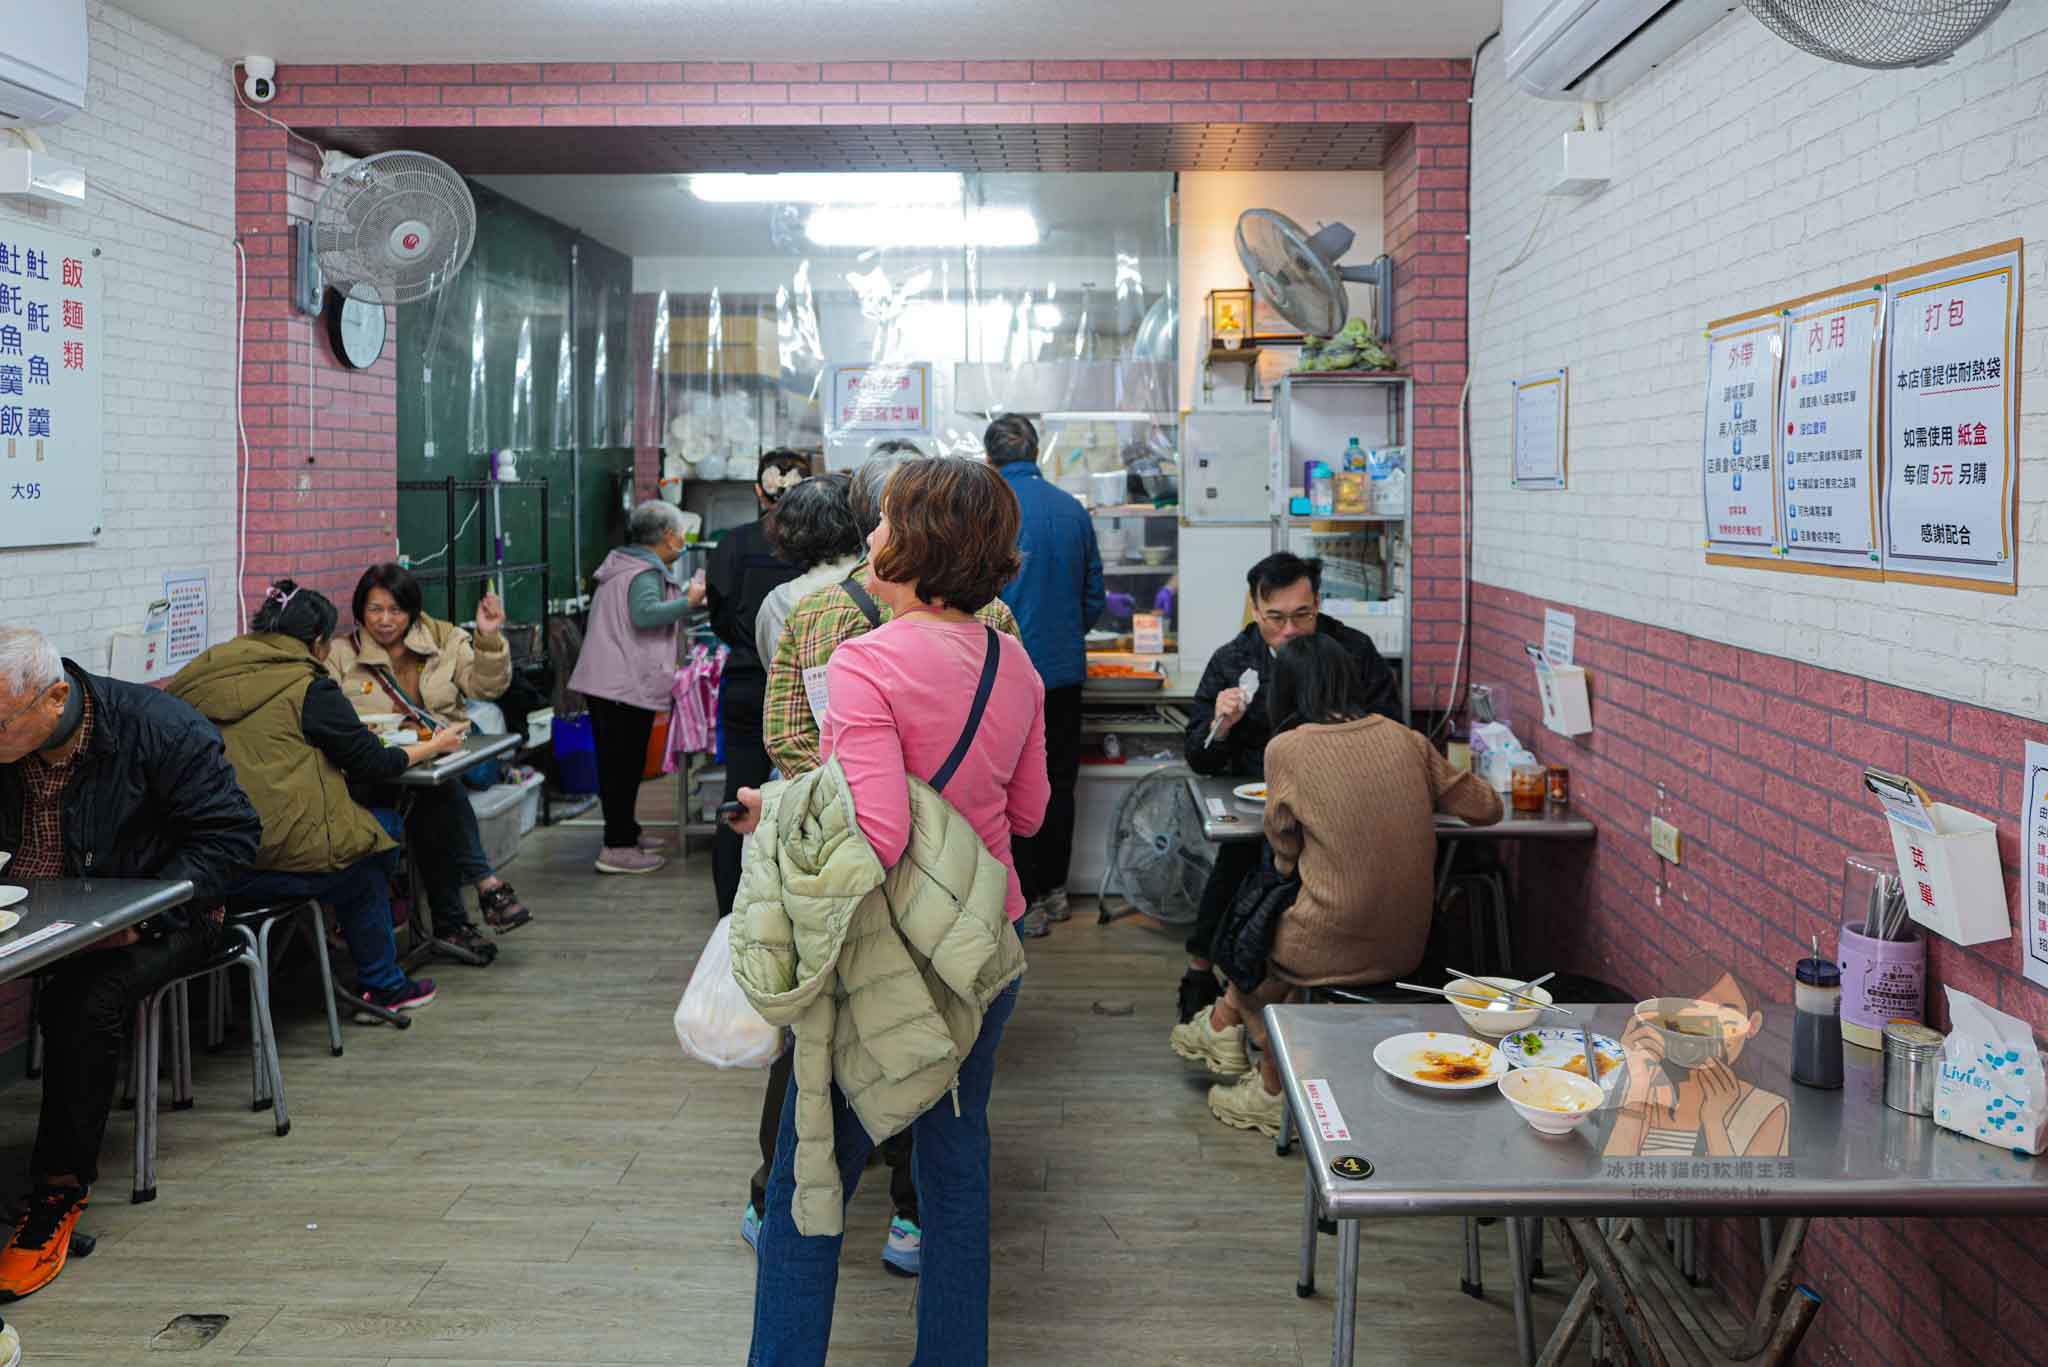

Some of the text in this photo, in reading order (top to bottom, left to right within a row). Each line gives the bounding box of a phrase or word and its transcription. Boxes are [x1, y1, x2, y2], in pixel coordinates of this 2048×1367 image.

[62, 257, 84, 371] 飯麵類
[1924, 298, 1965, 332] 打包
[1808, 316, 1846, 354] 內用
[1728, 342, 1754, 369] 外帶
[1897, 357, 2001, 390] 本店僅提供耐熱袋
[1904, 421, 1988, 449] 如需使用 紙盒
[1904, 462, 1987, 485] 每個 5元 另購
[11, 482, 41, 499] 大95
[1921, 524, 1971, 545] 感謝配合
[1910, 845, 1936, 907] 菜單
[1943, 1063, 1976, 1085] Livi
[1343, 1158, 1361, 1172] 4
